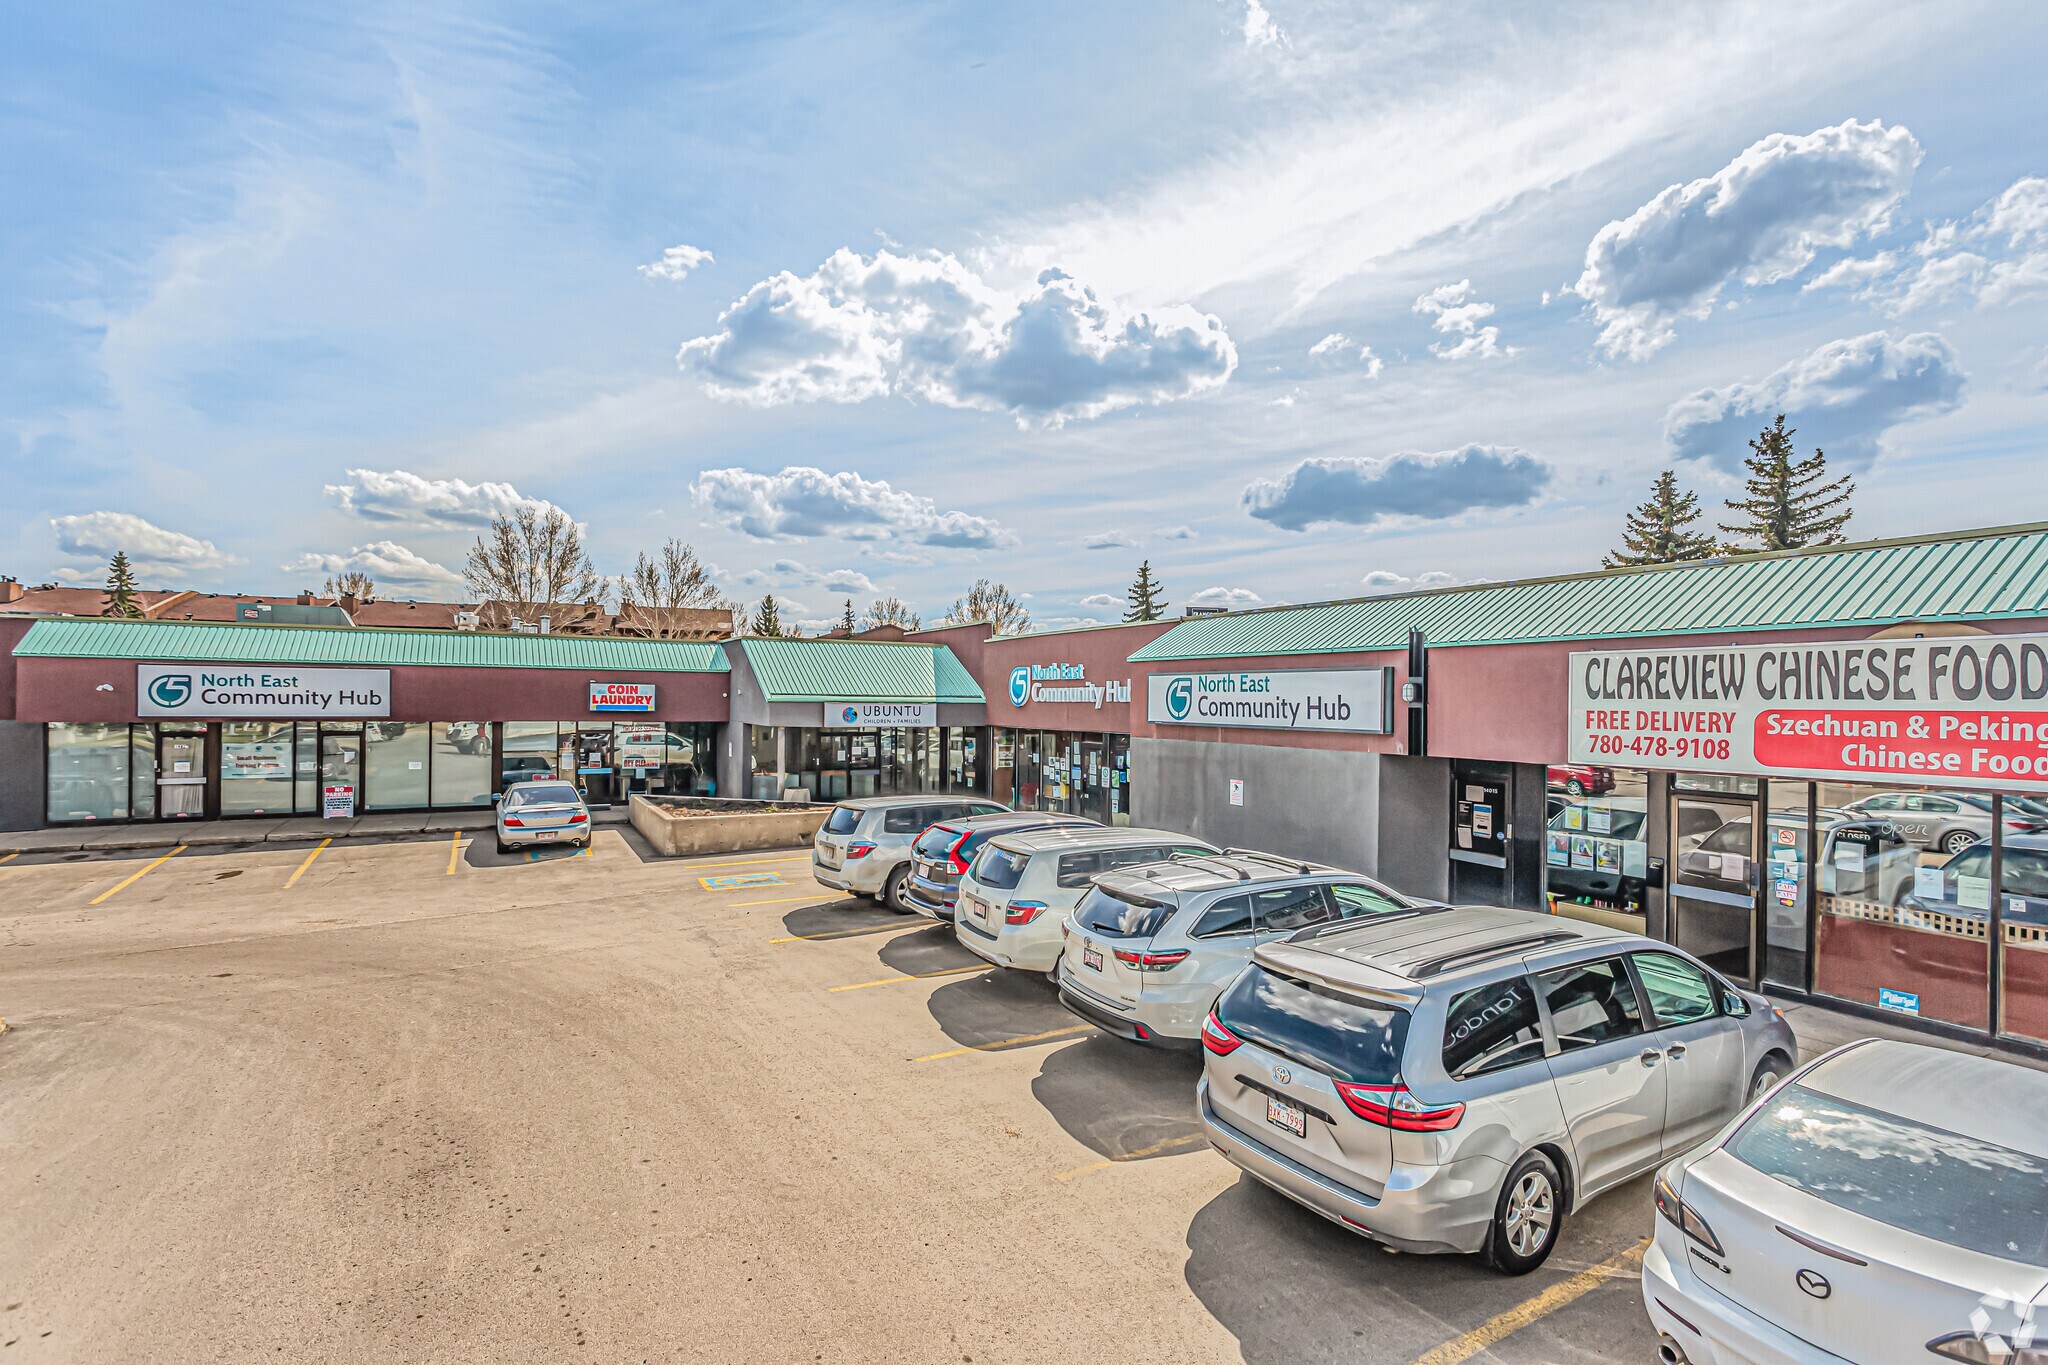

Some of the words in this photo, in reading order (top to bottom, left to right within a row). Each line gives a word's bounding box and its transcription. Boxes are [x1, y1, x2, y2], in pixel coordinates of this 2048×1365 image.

[201, 673, 255, 687] North
[261, 674, 299, 688] East
[1031, 663, 1061, 680] North
[1061, 663, 1085, 679] East
[1585, 653, 1746, 700] CLAREVIEW
[1756, 647, 1916, 700] CHINESE
[1929, 643, 2048, 701] FOOD
[607, 684, 639, 694] COIN
[1198, 674, 1235, 693] North
[1240, 674, 1270, 693] East
[201, 689, 333, 710] Community
[339, 690, 383, 706] Hub
[592, 695, 653, 704] LAUNDRY
[1031, 682, 1105, 709] Community
[863, 706, 921, 717] UBUNTU
[1198, 695, 1300, 727] Community
[1307, 695, 1351, 721] Hub
[1586, 710, 1630, 730] FREE
[1636, 711, 1737, 733] DELIVERY
[1766, 714, 1898, 738] Szechuan
[1905, 715, 1931, 739] &
[1588, 735, 1730, 760] 780-478-9108
[1841, 743, 1962, 771] Chinese
